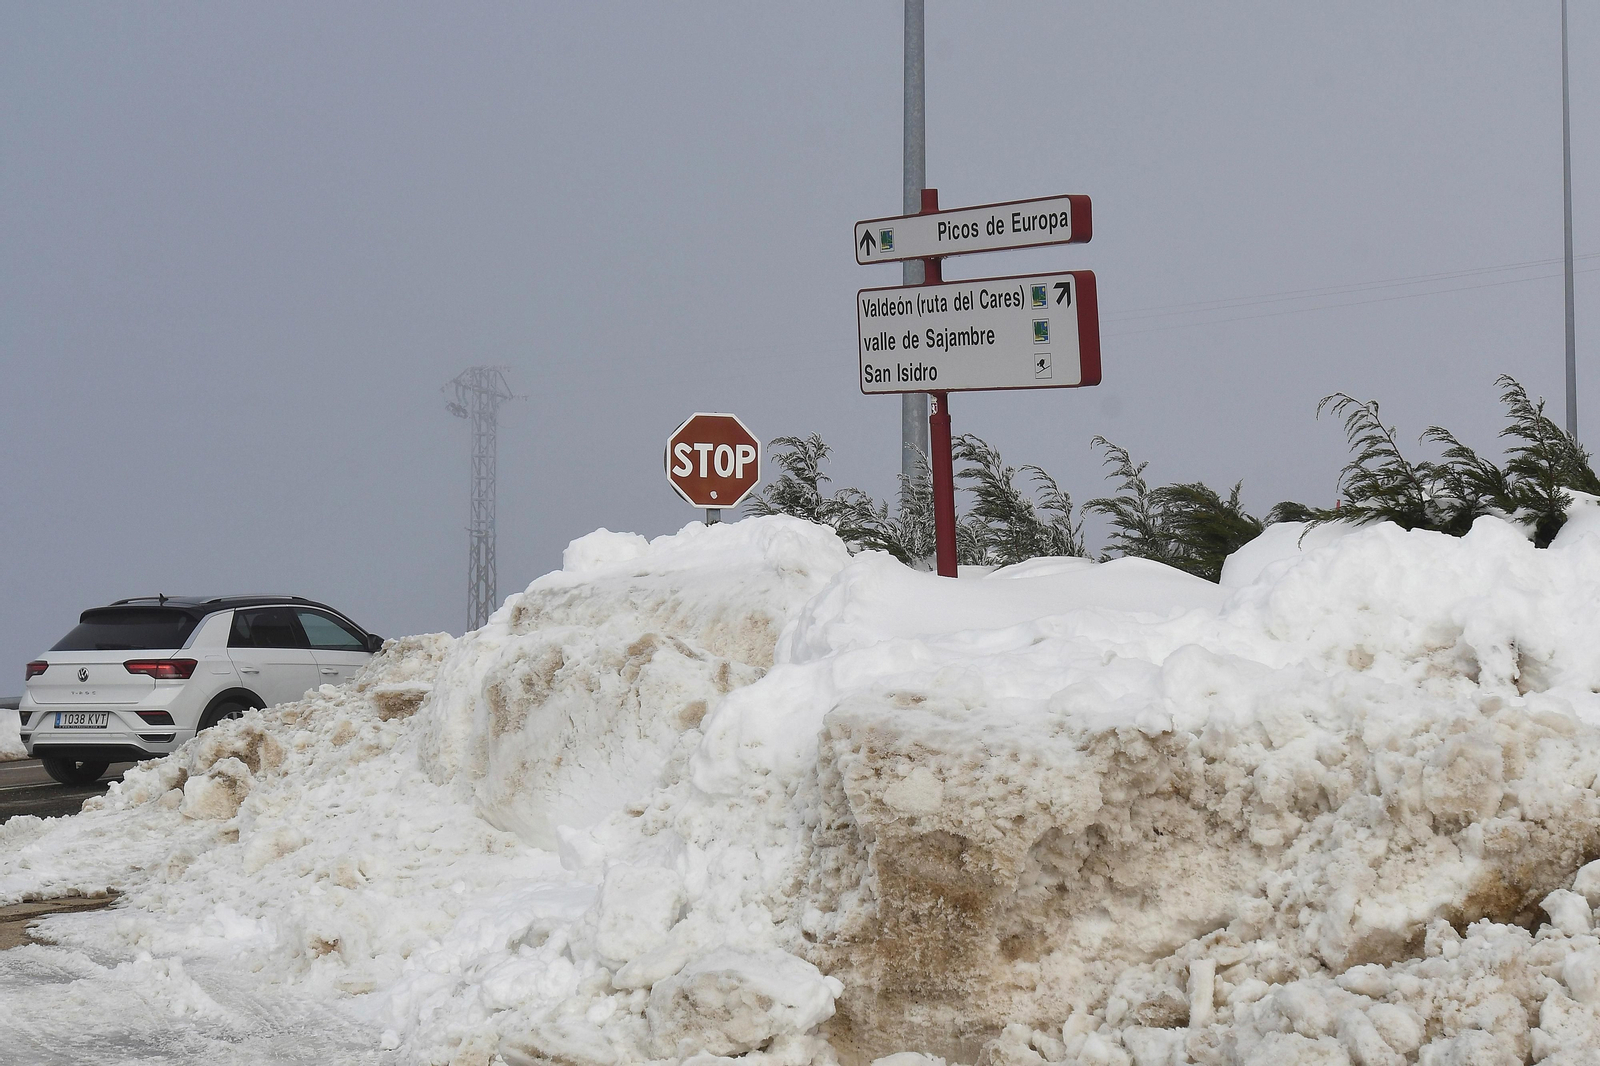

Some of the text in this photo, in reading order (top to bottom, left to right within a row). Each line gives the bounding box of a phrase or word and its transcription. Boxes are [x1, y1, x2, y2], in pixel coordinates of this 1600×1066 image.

[937, 211, 1069, 242] Picos de Europa
[862, 284, 1026, 318] Valdeón (ruta del Cares)
[863, 326, 996, 352] valle de Sajambre
[864, 363, 938, 384] San Isidro
[672, 442, 757, 479] STOP
[64, 713, 106, 725] 1038 KVT
